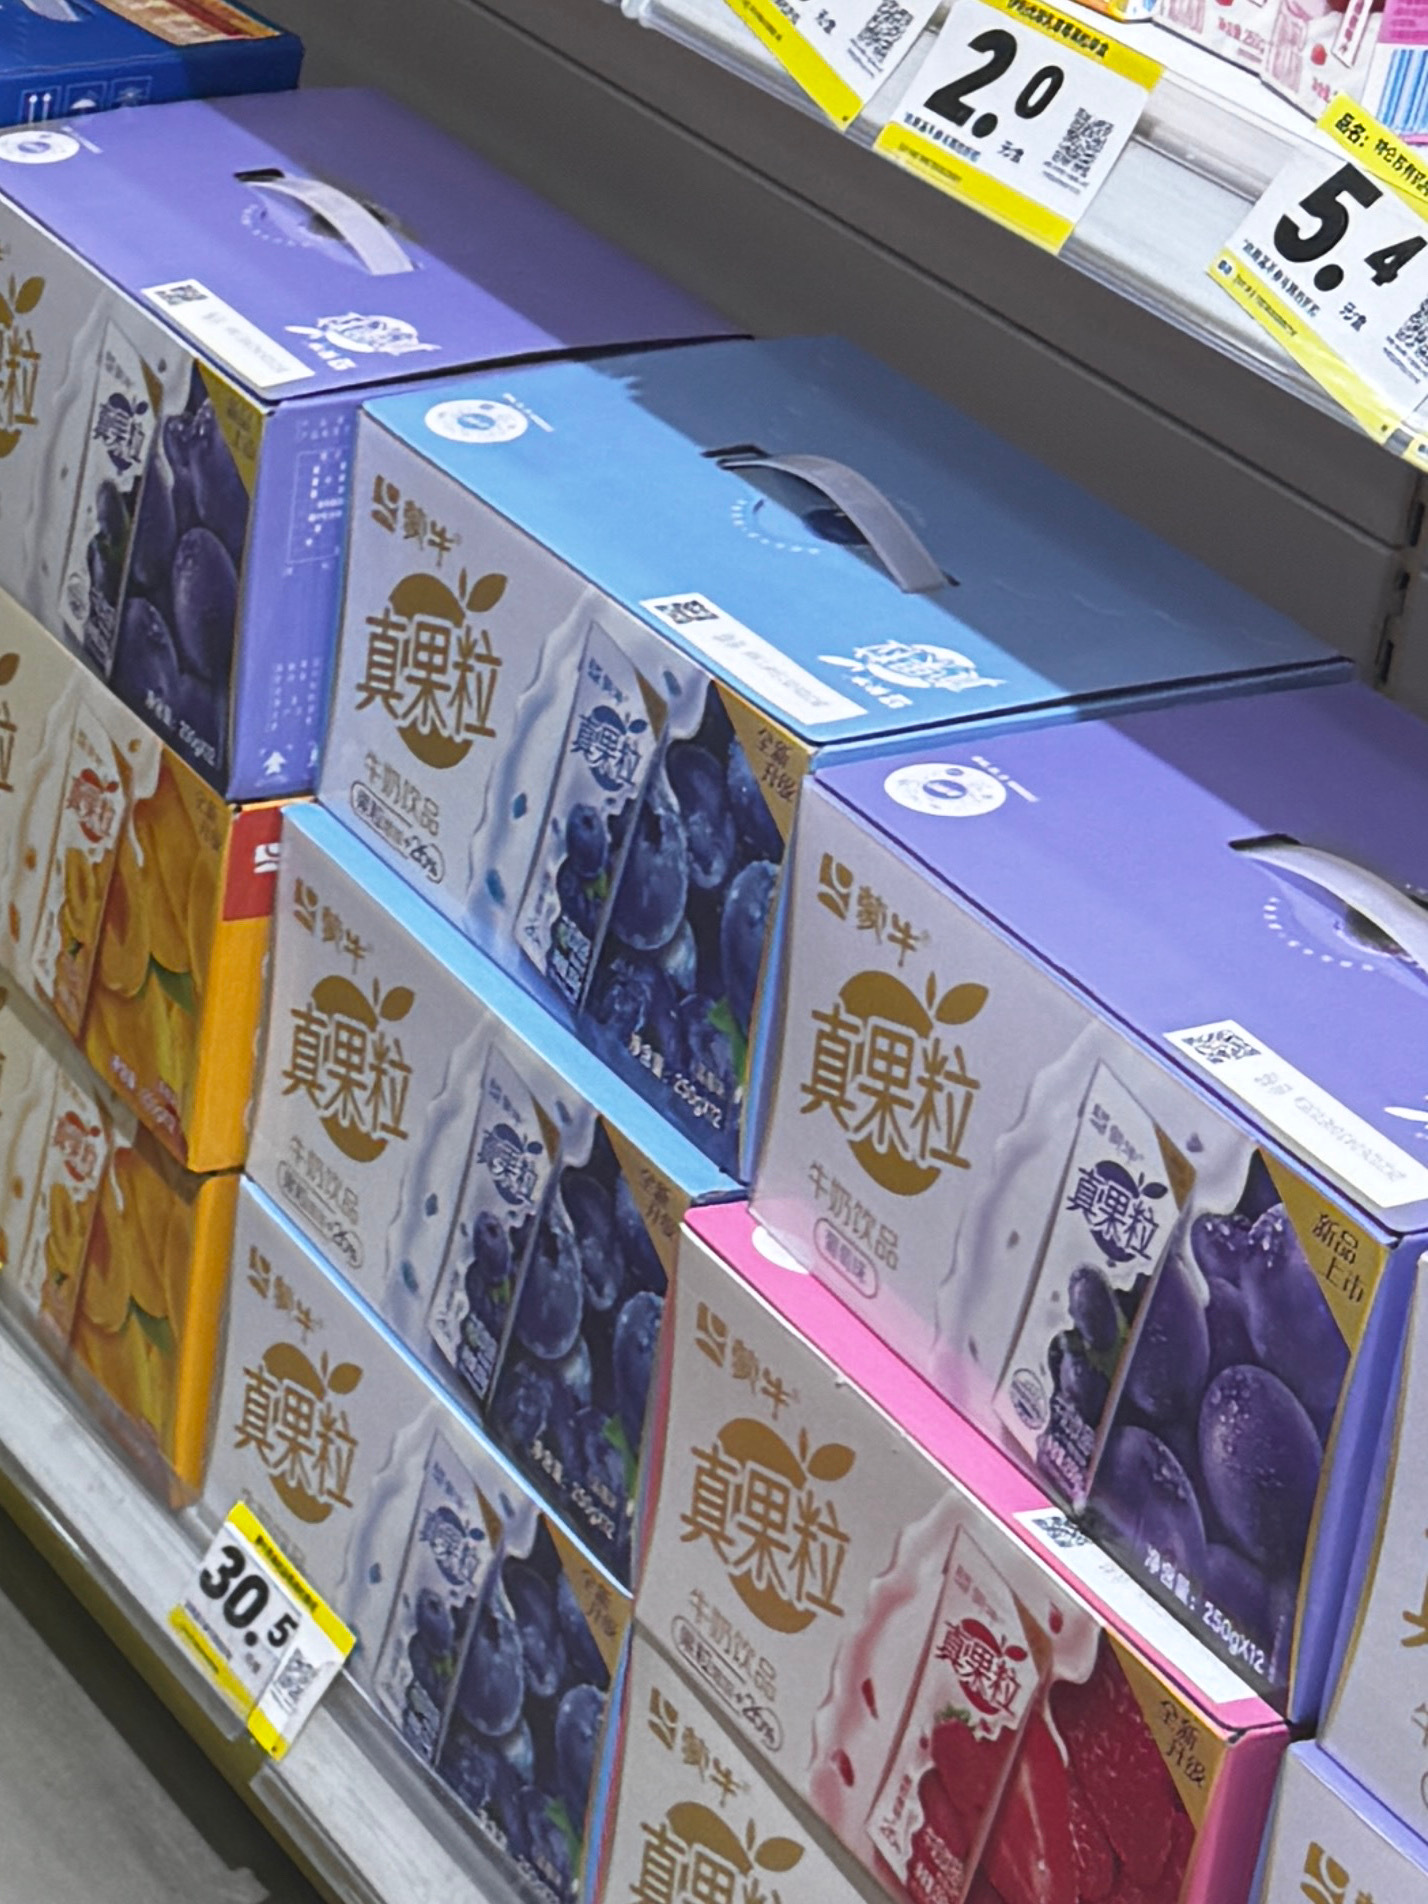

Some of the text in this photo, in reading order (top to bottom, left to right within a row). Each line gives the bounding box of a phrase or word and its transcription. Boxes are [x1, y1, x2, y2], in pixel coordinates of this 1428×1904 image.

[923, 29, 1064, 138] 2.0
[1273, 162, 1428, 293] 5.4
[403, 500, 454, 566] 蒙牛
[355, 605, 503, 742] 真果粒
[858, 885, 920, 966] 蒙牛
[283, 1007, 412, 1143] 真果粒
[800, 1004, 982, 1170] 真果粒
[808, 1161, 900, 1270] 牛奶饮品
[1065, 1166, 1162, 1260] 真果粒
[1312, 1214, 1359, 1265] 新品
[235, 1362, 356, 1509] 真果粒
[680, 1442, 853, 1621] 真果粒
[198, 1544, 298, 1647] 30.5
[689, 1589, 777, 1700] 牛奶饮品
[1202, 1601, 1267, 1672] 250gX12
[935, 1627, 1027, 1714] 真果粒
[682, 1727, 740, 1805] 蒙牛
